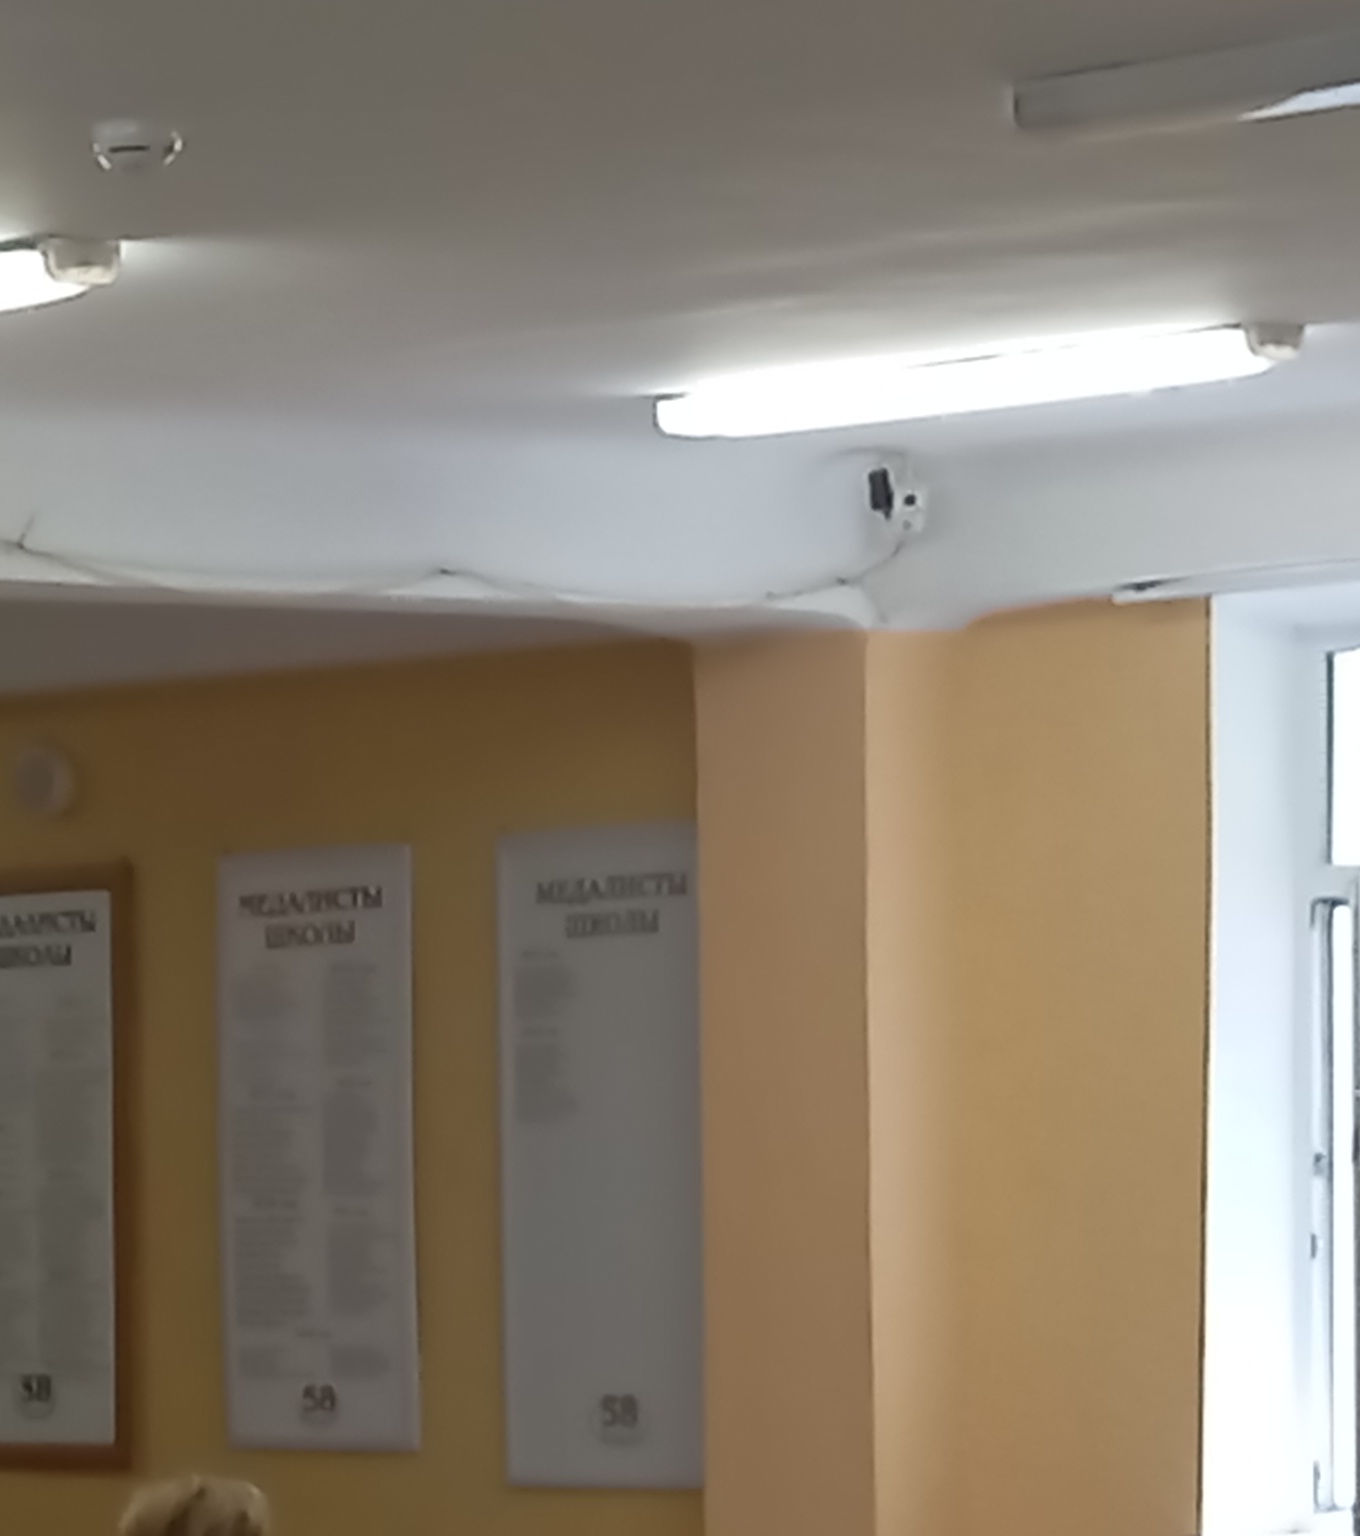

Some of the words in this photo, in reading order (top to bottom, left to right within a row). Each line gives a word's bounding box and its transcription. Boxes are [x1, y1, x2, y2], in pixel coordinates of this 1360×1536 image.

[536, 873, 687, 906] МЕДАЛИСТЫ
[302, 1384, 337, 1413] 58
[599, 1394, 638, 1428] 58
